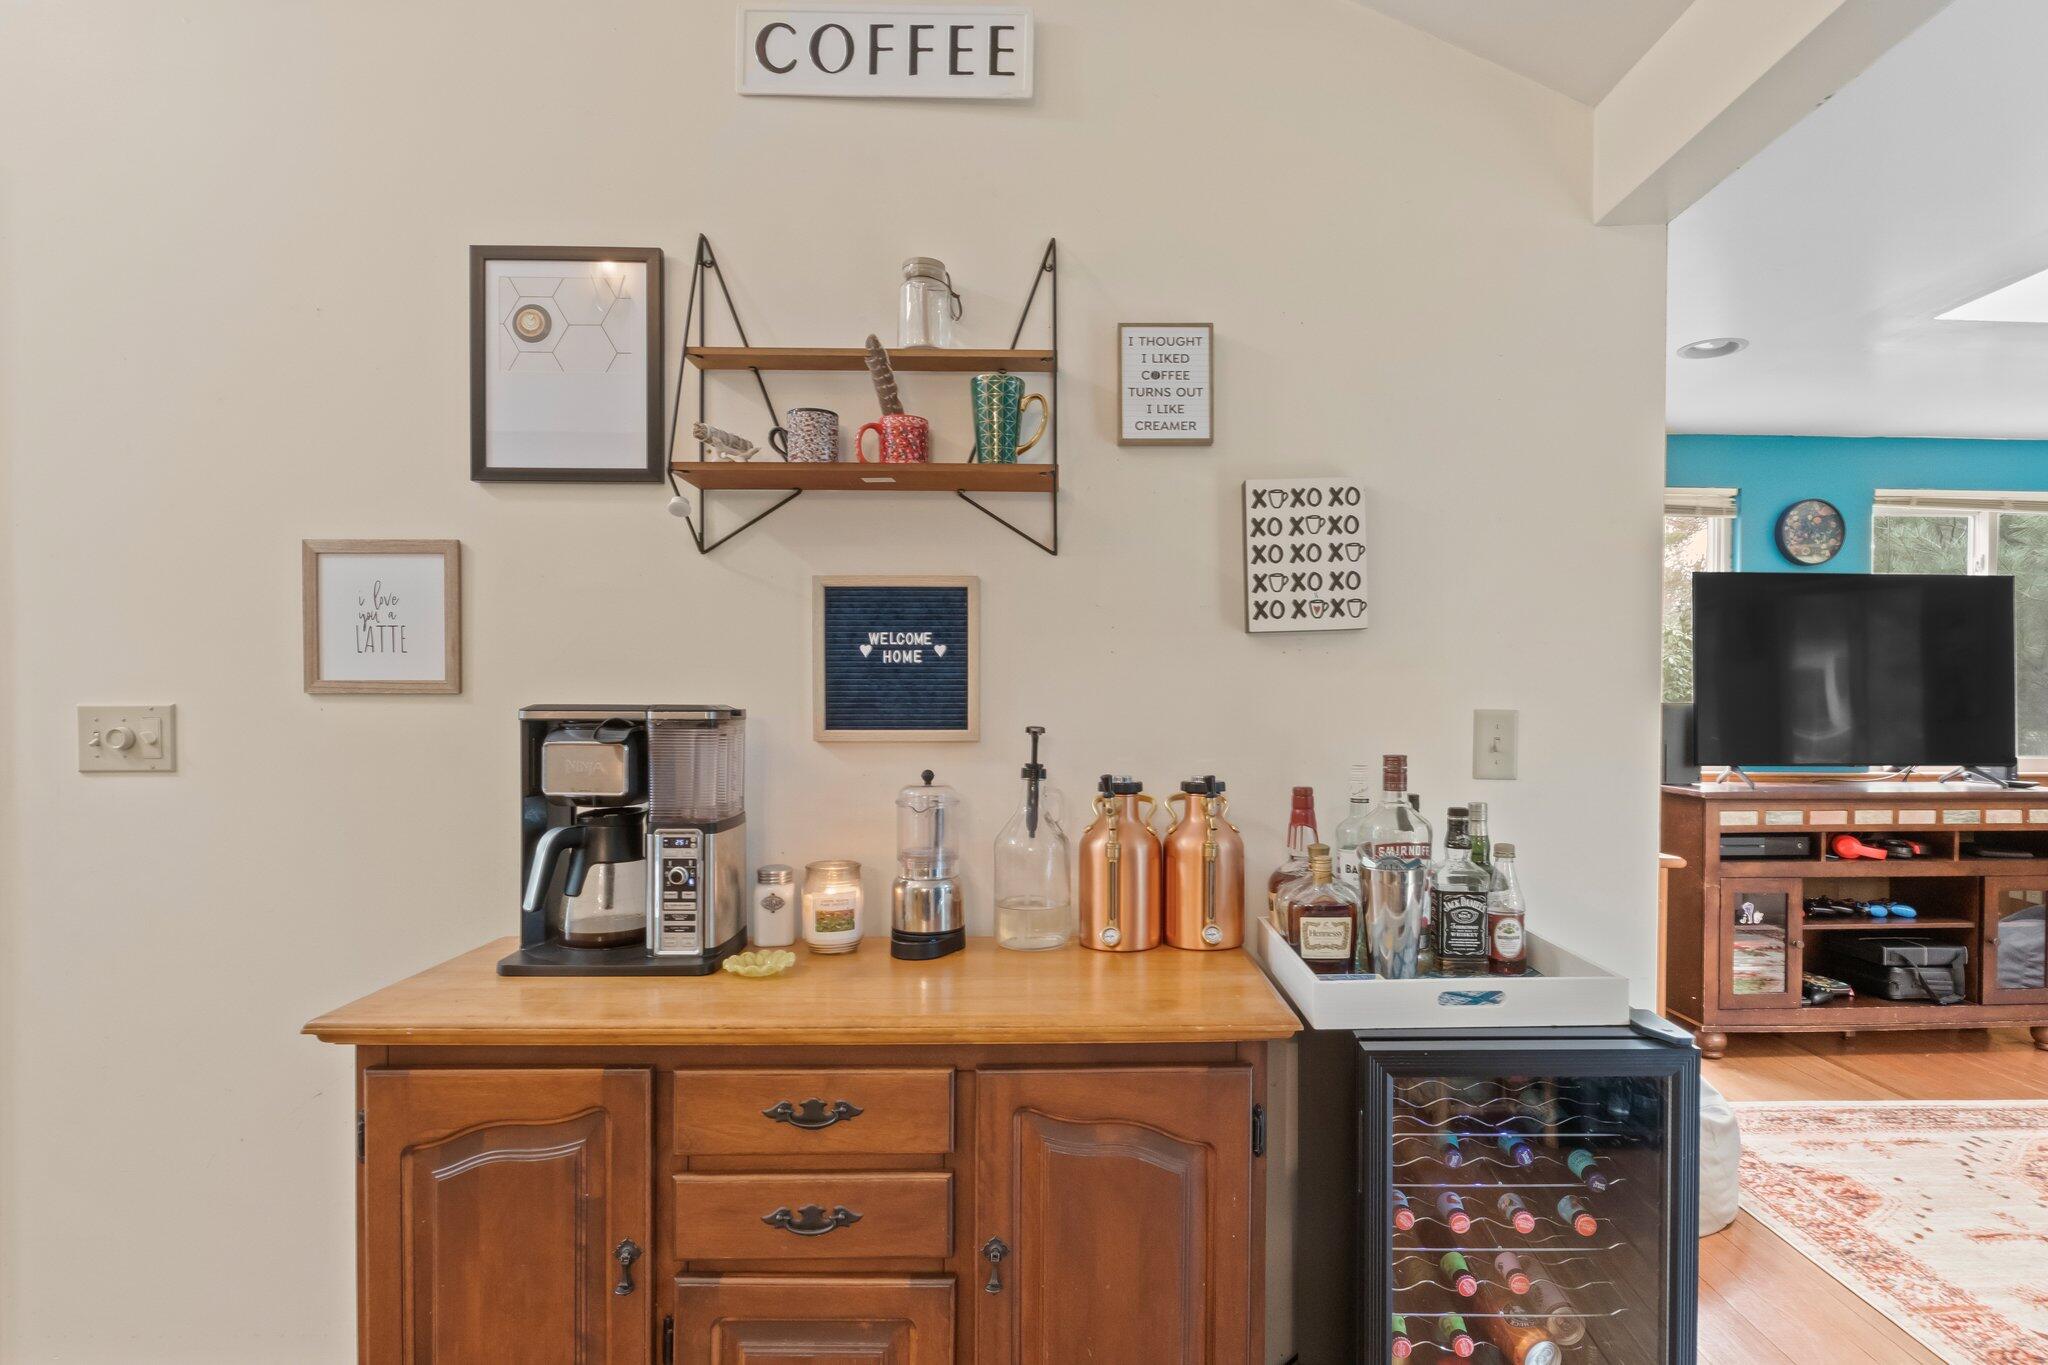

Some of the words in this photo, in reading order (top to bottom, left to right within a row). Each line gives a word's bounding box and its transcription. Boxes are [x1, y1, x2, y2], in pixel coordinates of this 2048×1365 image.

[754, 22, 1016, 76] COFFEE
[1128, 336, 1134, 347] I
[1138, 336, 1203, 347] THOUGHT
[1141, 353, 1147, 364] I
[1151, 353, 1191, 364] LIKED
[1127, 387, 1172, 398] TURNS
[1175, 387, 1204, 398] OUT
[1146, 404, 1152, 415] I
[1156, 404, 1185, 415] LIKE
[1134, 420, 1197, 431] CREAMER
[373, 580, 400, 610] love
[358, 610, 380, 632] you
[387, 611, 397, 620] a
[355, 624, 408, 654] LATTE
[868, 631, 933, 646] WELCOME
[882, 649, 923, 664] HOME
[1378, 845, 1430, 857] SMIRNOFF
[1308, 929, 1343, 938] Hennessy
